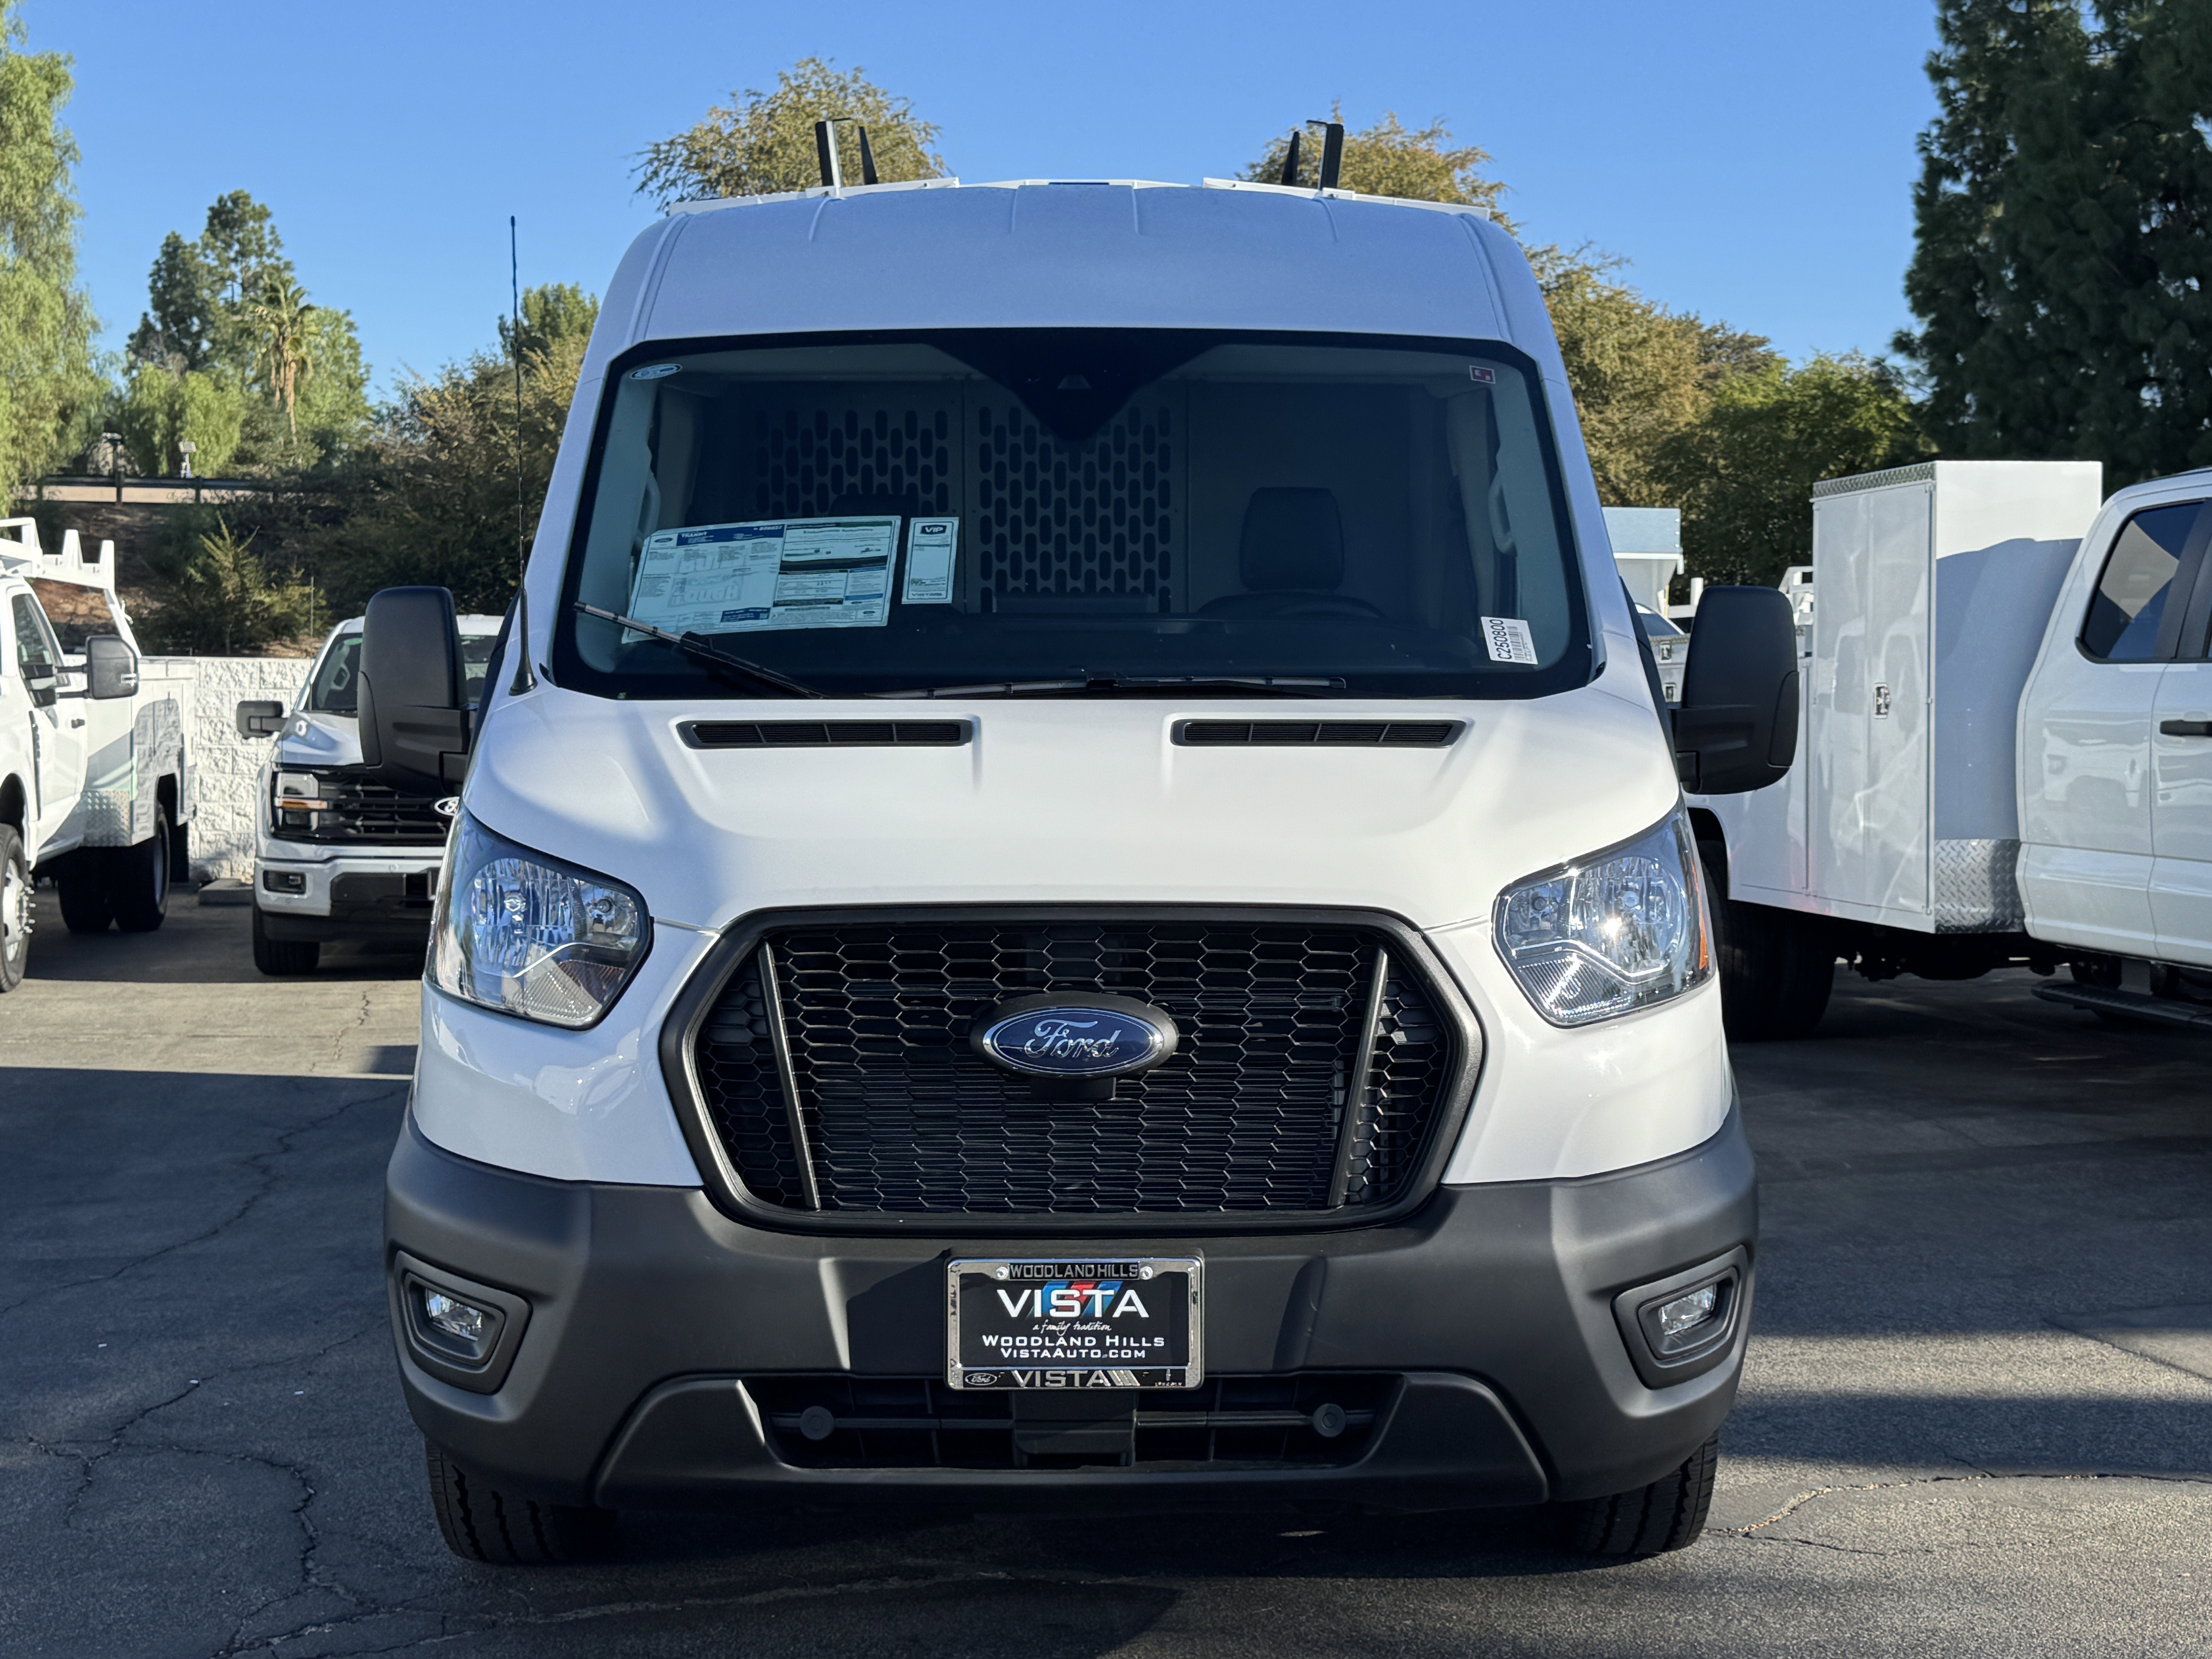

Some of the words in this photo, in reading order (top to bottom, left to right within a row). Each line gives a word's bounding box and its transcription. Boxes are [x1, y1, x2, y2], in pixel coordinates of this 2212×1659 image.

[1489, 619, 1512, 659] C250800
[1025, 1018, 1122, 1059] Ford
[1010, 1264, 1094, 1278] WOODLAND
[1097, 1264, 1139, 1278] HILLS
[996, 1289, 1150, 1318] VISTA
[1041, 1319, 1071, 1336] family
[1073, 1321, 1112, 1331] tradition
[1011, 1370, 1111, 1387] VISTA
